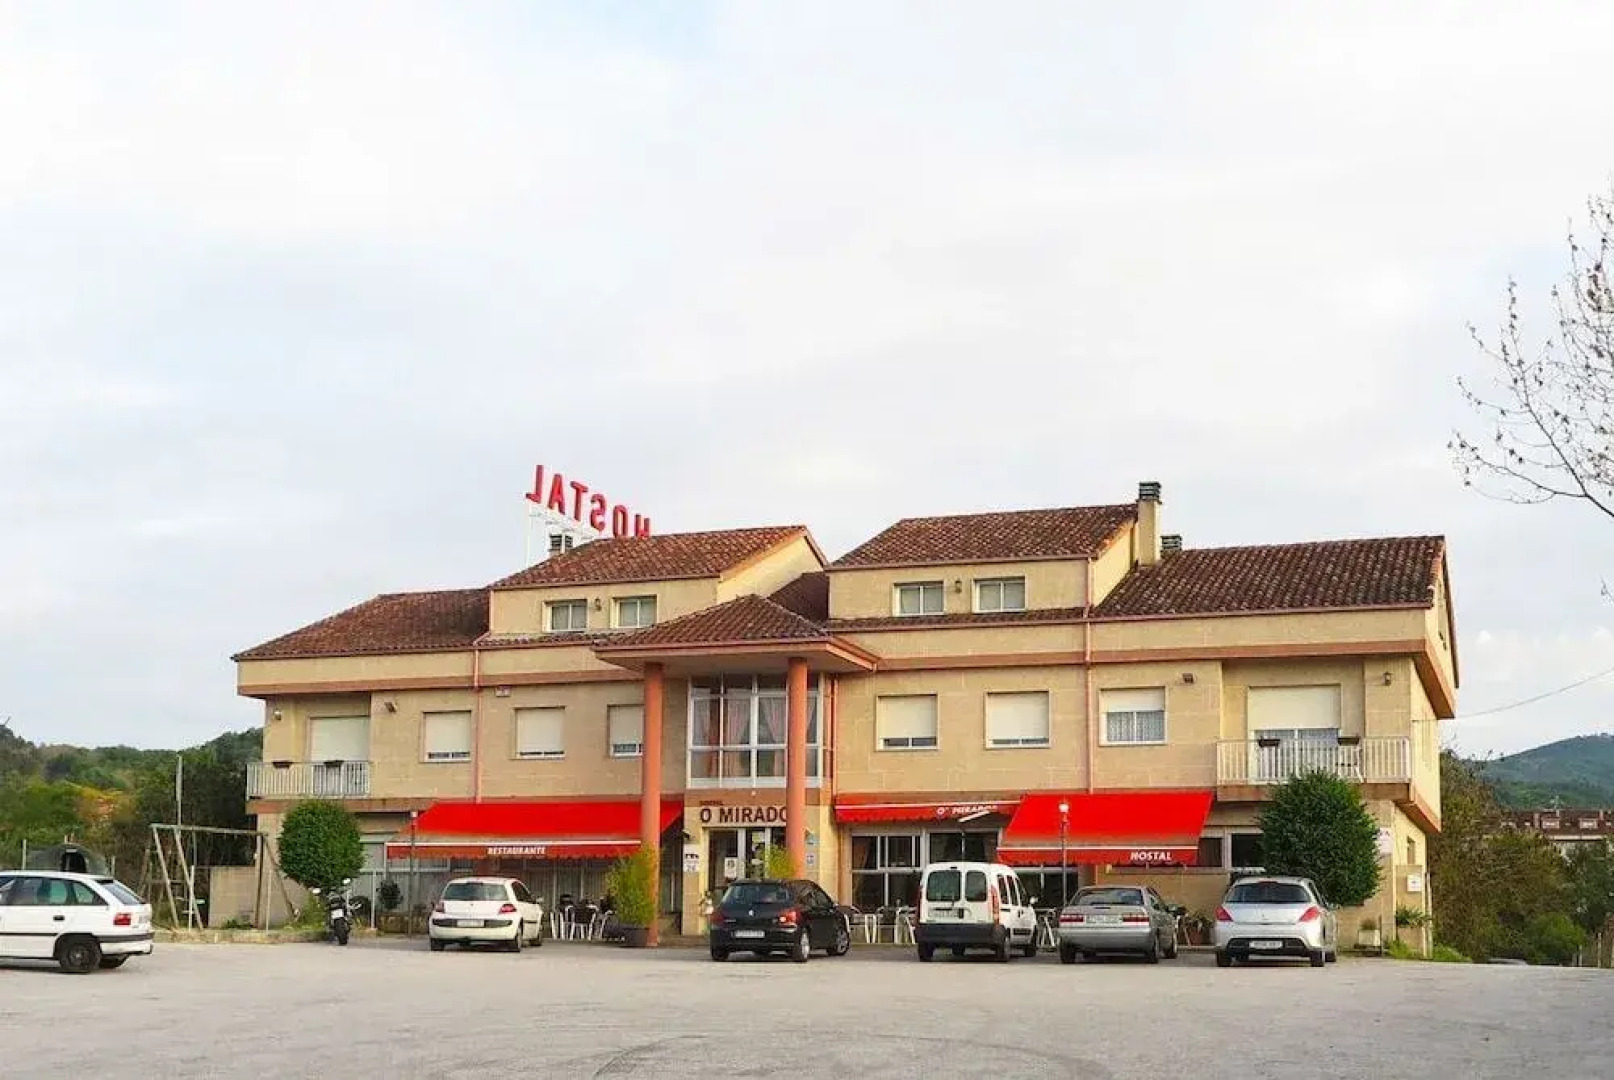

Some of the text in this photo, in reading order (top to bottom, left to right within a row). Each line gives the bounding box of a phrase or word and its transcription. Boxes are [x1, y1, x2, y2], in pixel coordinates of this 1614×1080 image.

[700, 806, 787, 823] O MIRADO
[487, 846, 546, 855] RESTAURANTE
[1130, 850, 1173, 861] HOSTAL
